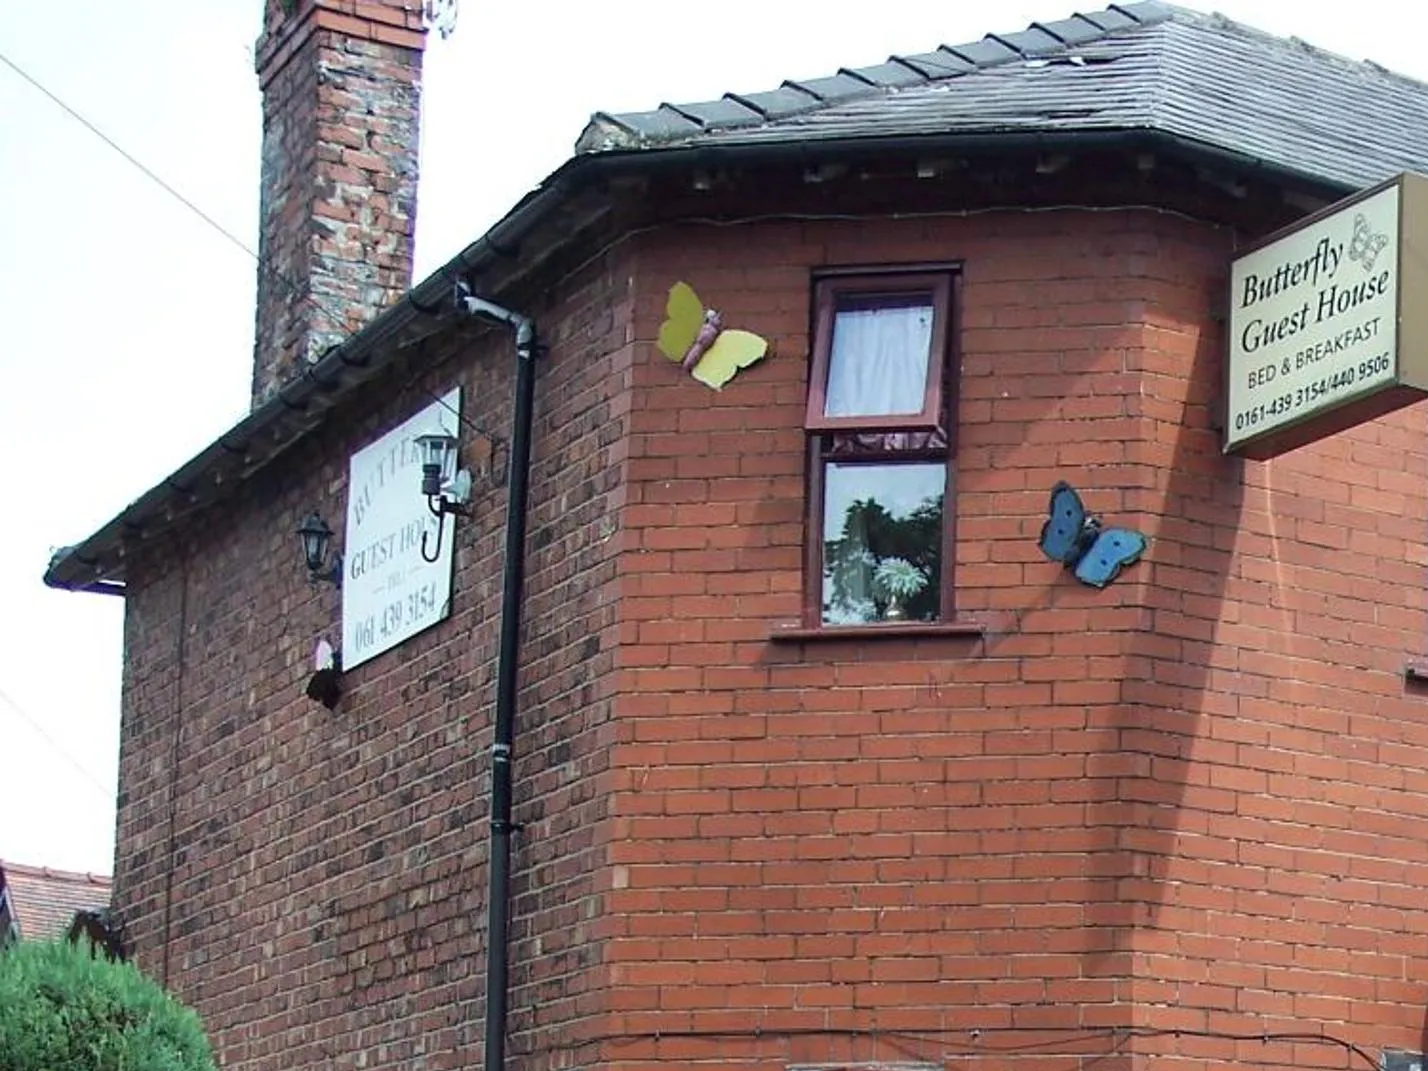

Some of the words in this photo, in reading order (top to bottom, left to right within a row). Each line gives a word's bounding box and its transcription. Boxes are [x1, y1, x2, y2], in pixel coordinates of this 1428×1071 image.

[1241, 238, 1343, 308] Butterfly
[1242, 303, 1310, 353] Guest
[1315, 270, 1389, 324] House
[1248, 363, 1276, 389] BED
[1281, 357, 1291, 377] &
[1295, 317, 1381, 369] BREAKFAST
[1235, 394, 1292, 430] 0161-439
[1296, 368, 1354, 405] 3154/440
[1359, 352, 1389, 382] 9506
[351, 532, 396, 580] GUEST
